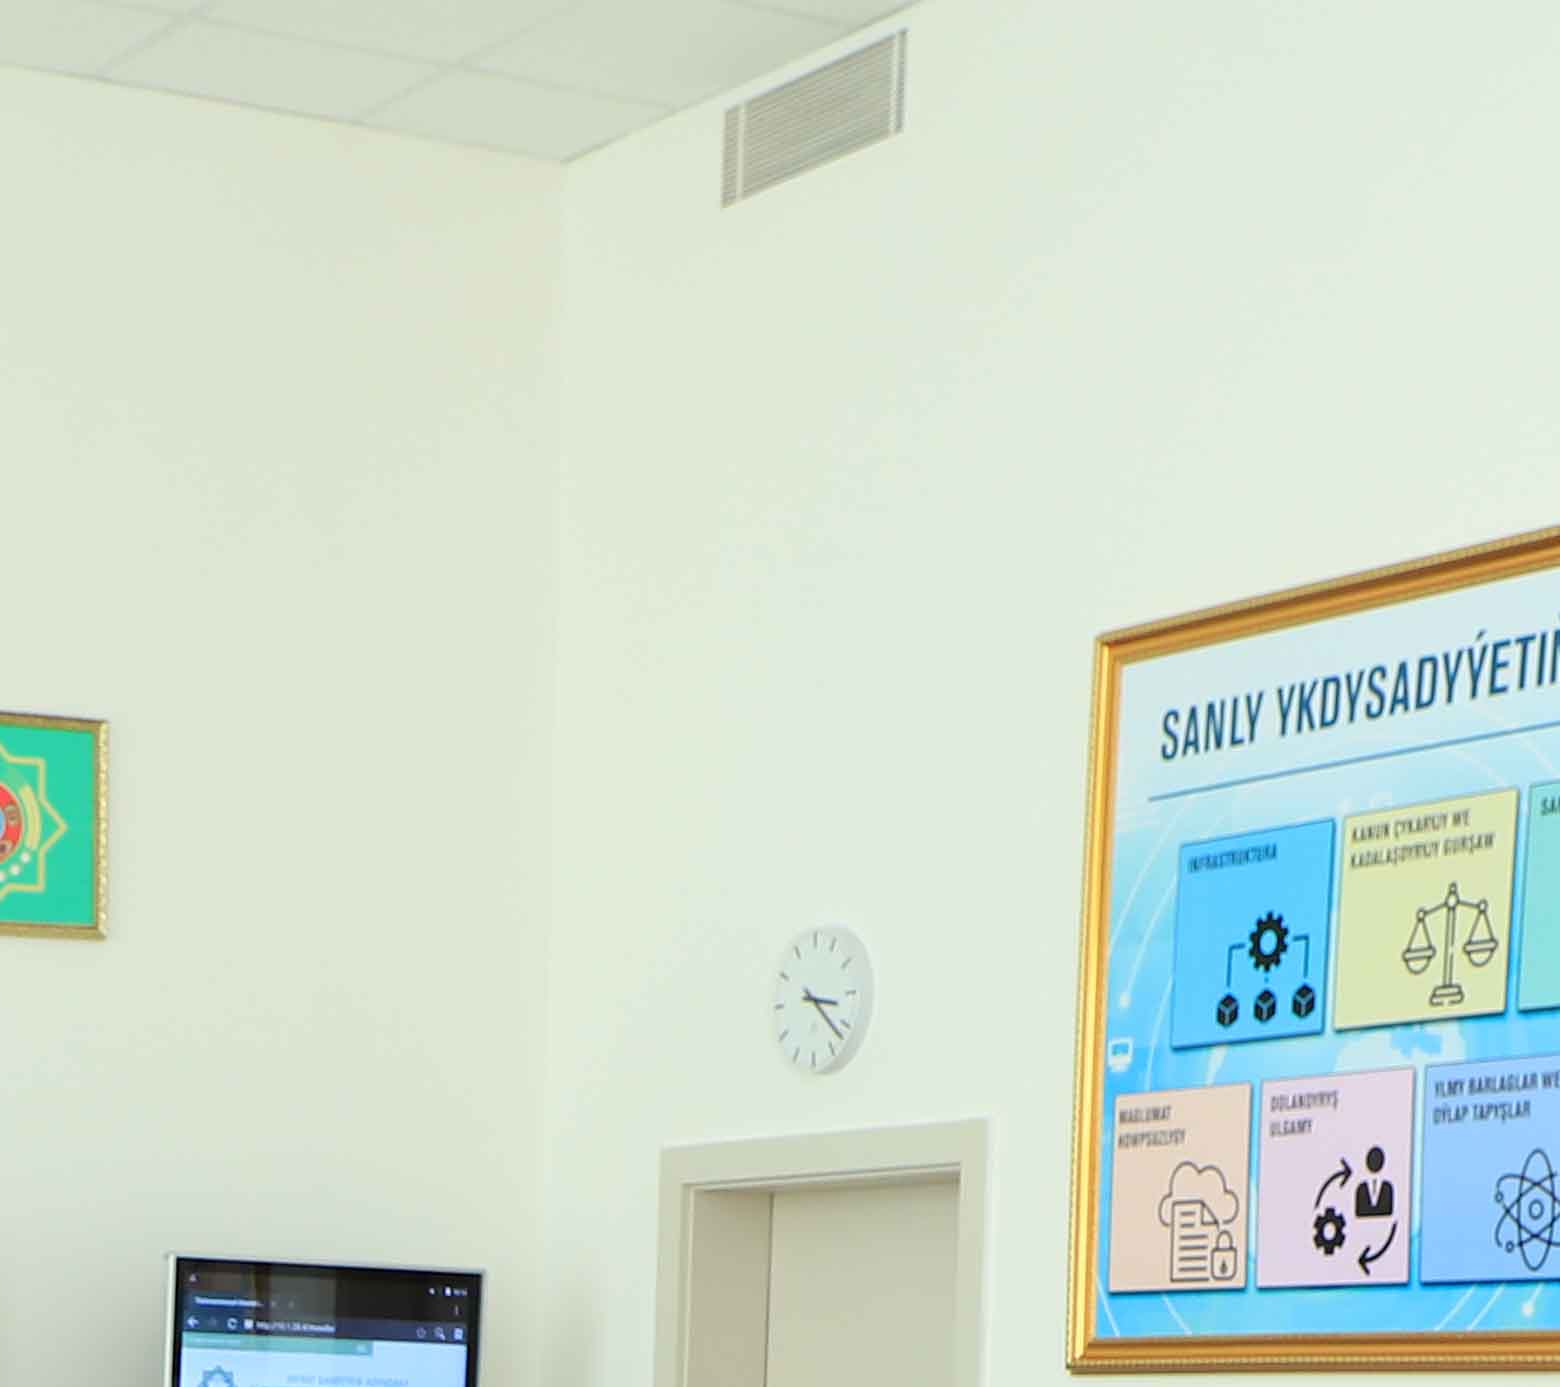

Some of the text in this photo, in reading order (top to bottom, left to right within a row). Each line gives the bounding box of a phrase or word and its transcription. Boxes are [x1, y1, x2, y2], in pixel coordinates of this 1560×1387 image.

[1161, 690, 1264, 761] SANLY
[1434, 1069, 1560, 1099] YLMY BARLAGLAR WE
[1472, 1099, 1531, 1123] TAPYŞLAR
